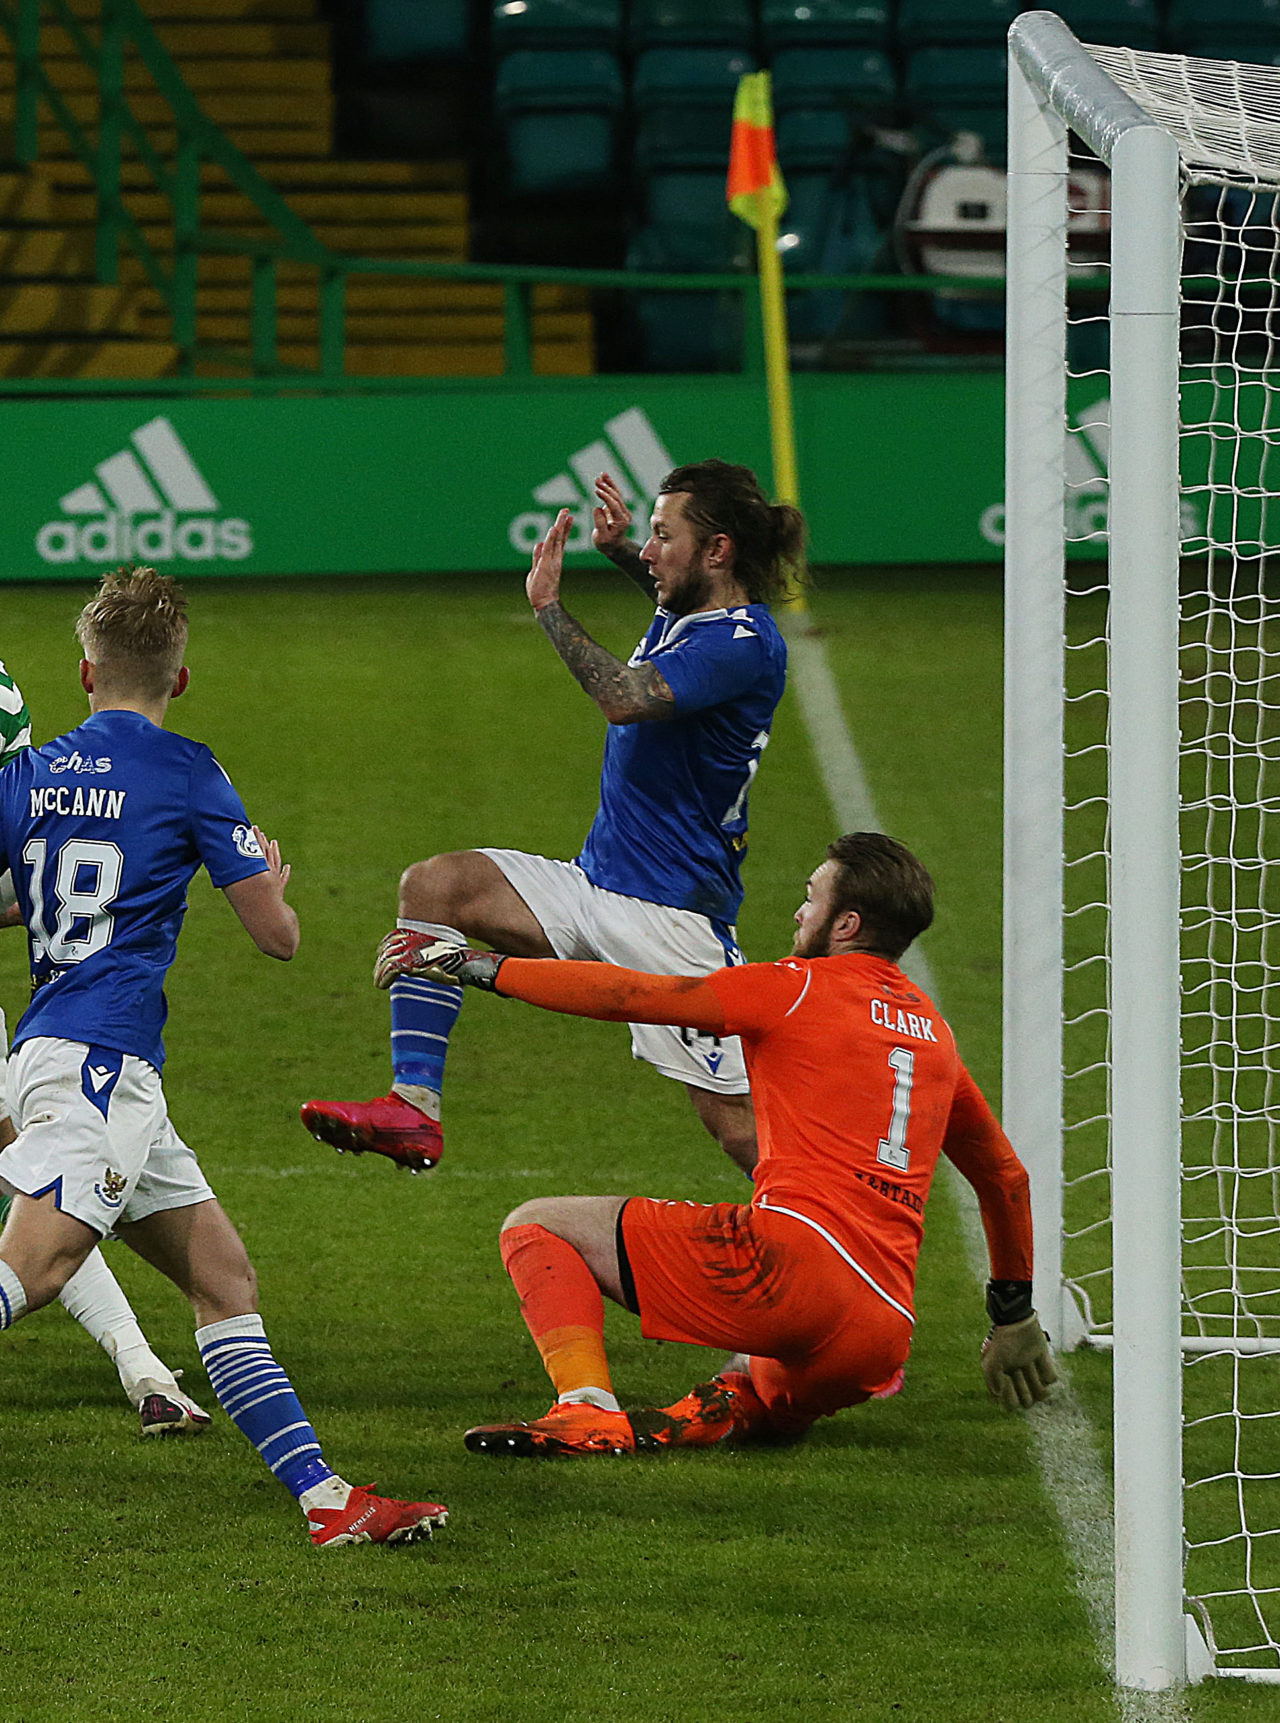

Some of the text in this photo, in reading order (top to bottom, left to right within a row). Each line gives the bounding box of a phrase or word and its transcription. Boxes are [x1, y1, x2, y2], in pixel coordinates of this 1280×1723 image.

[35, 510, 254, 563] adidas
[22, 837, 125, 964] 18
[871, 998, 939, 1043] CLARK
[877, 1046, 914, 1172] 1
